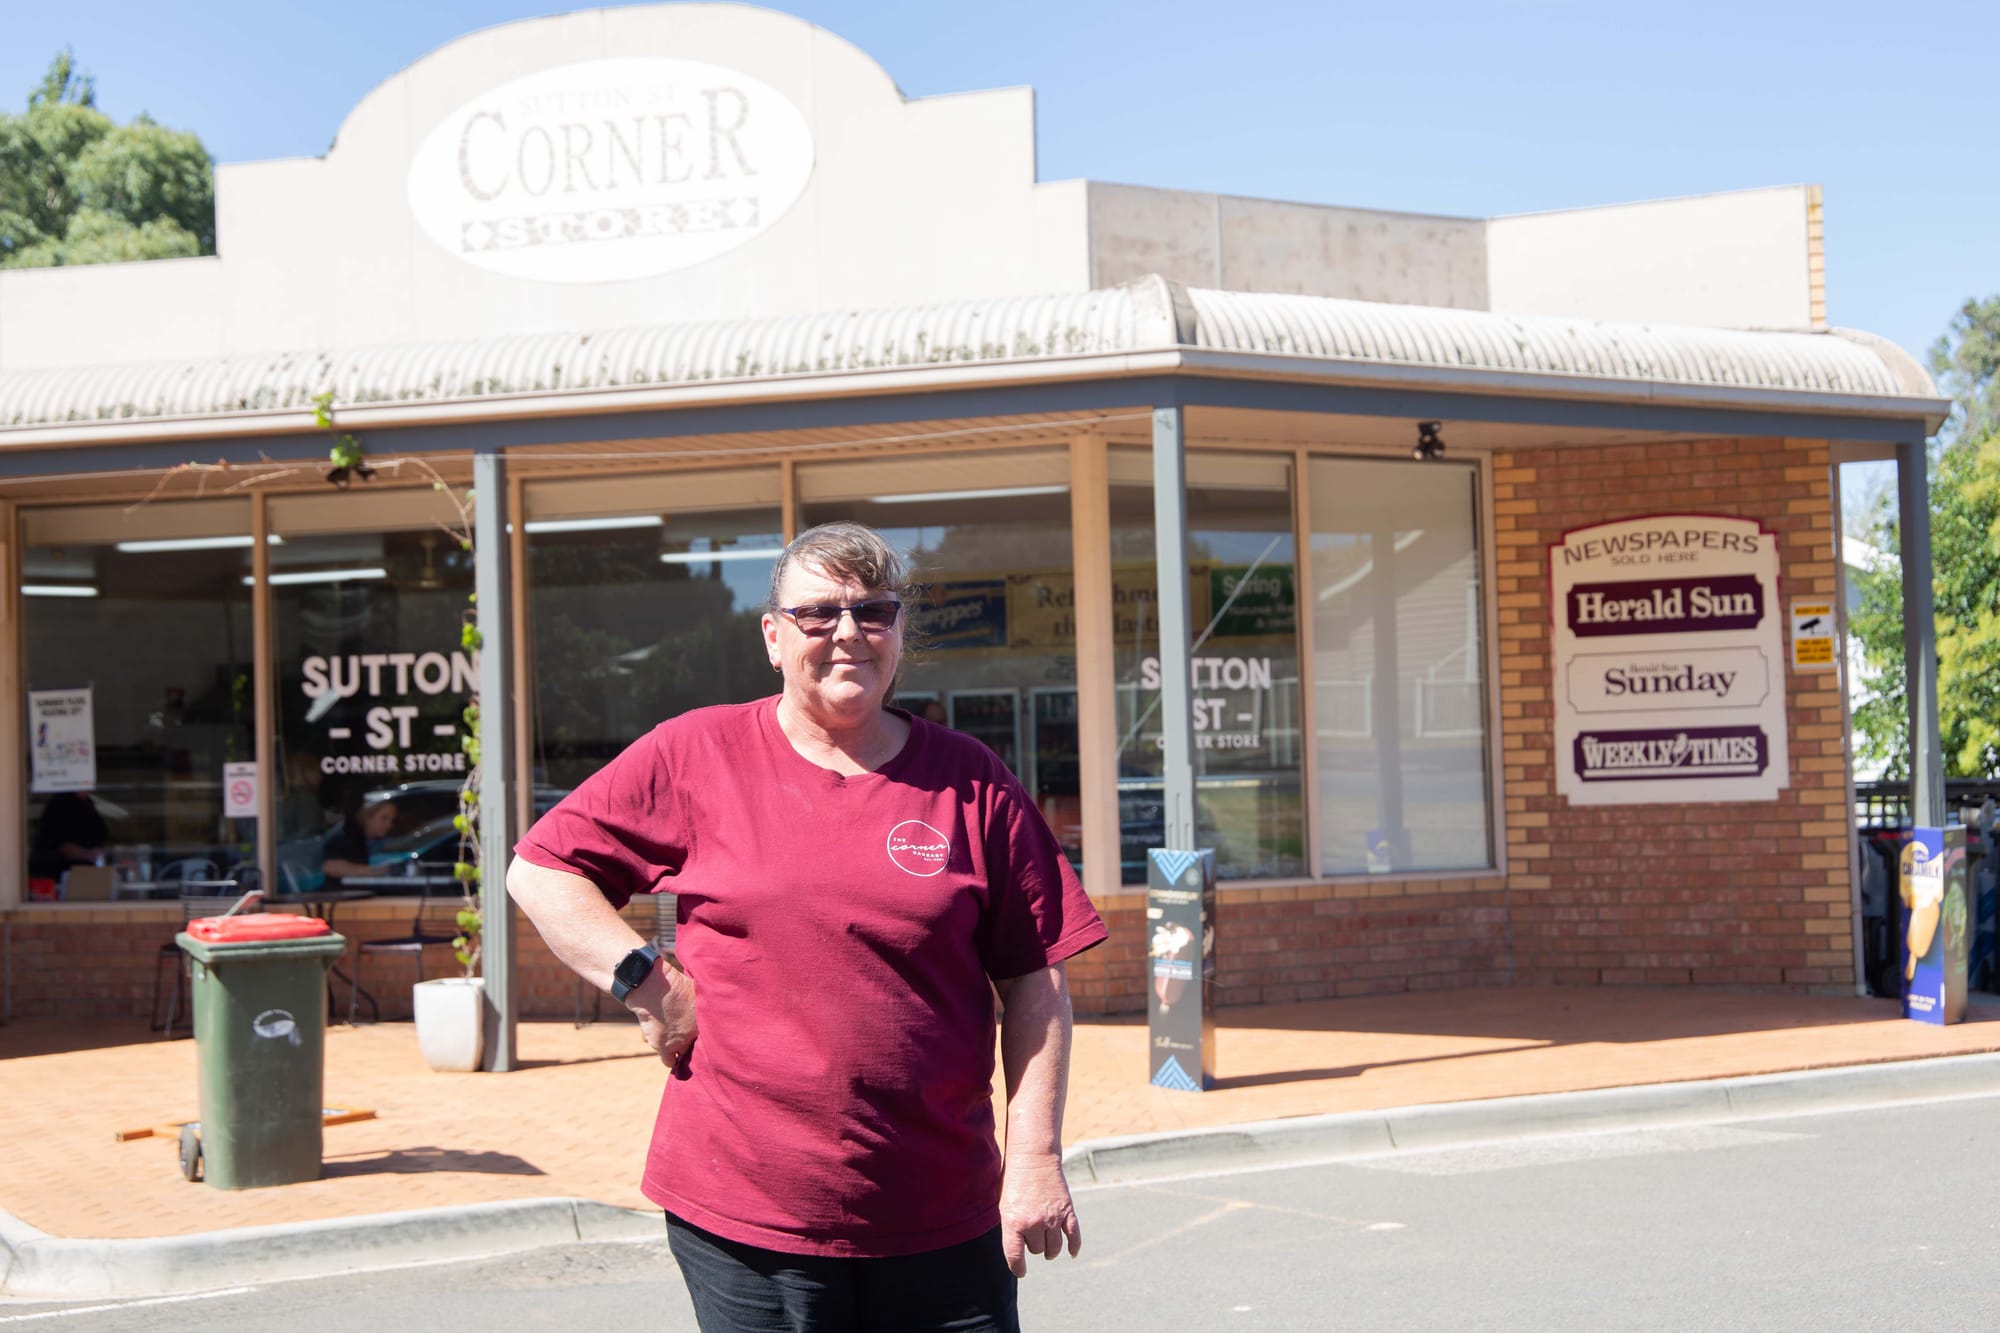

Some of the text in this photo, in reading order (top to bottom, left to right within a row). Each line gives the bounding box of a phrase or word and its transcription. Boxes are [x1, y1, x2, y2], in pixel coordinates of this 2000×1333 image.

[518, 84, 632, 118] SUTTON
[457, 84, 760, 201] CORNER
[497, 200, 722, 246] STORE
[1563, 529, 1760, 566] NEWSPAPERS
[1611, 551, 1698, 567] SOLD HERE
[1575, 585, 1756, 625] Herald Sun
[301, 651, 481, 698] SUTTON
[1141, 657, 1271, 690] STTON
[1604, 664, 1738, 698] Sunday
[366, 706, 419, 749] ST
[1191, 698, 1227, 731] ST
[1216, 734, 1260, 749] STORE
[1583, 736, 1759, 769] WEEKLY TIMES
[320, 752, 466, 773] CORNER STORE
